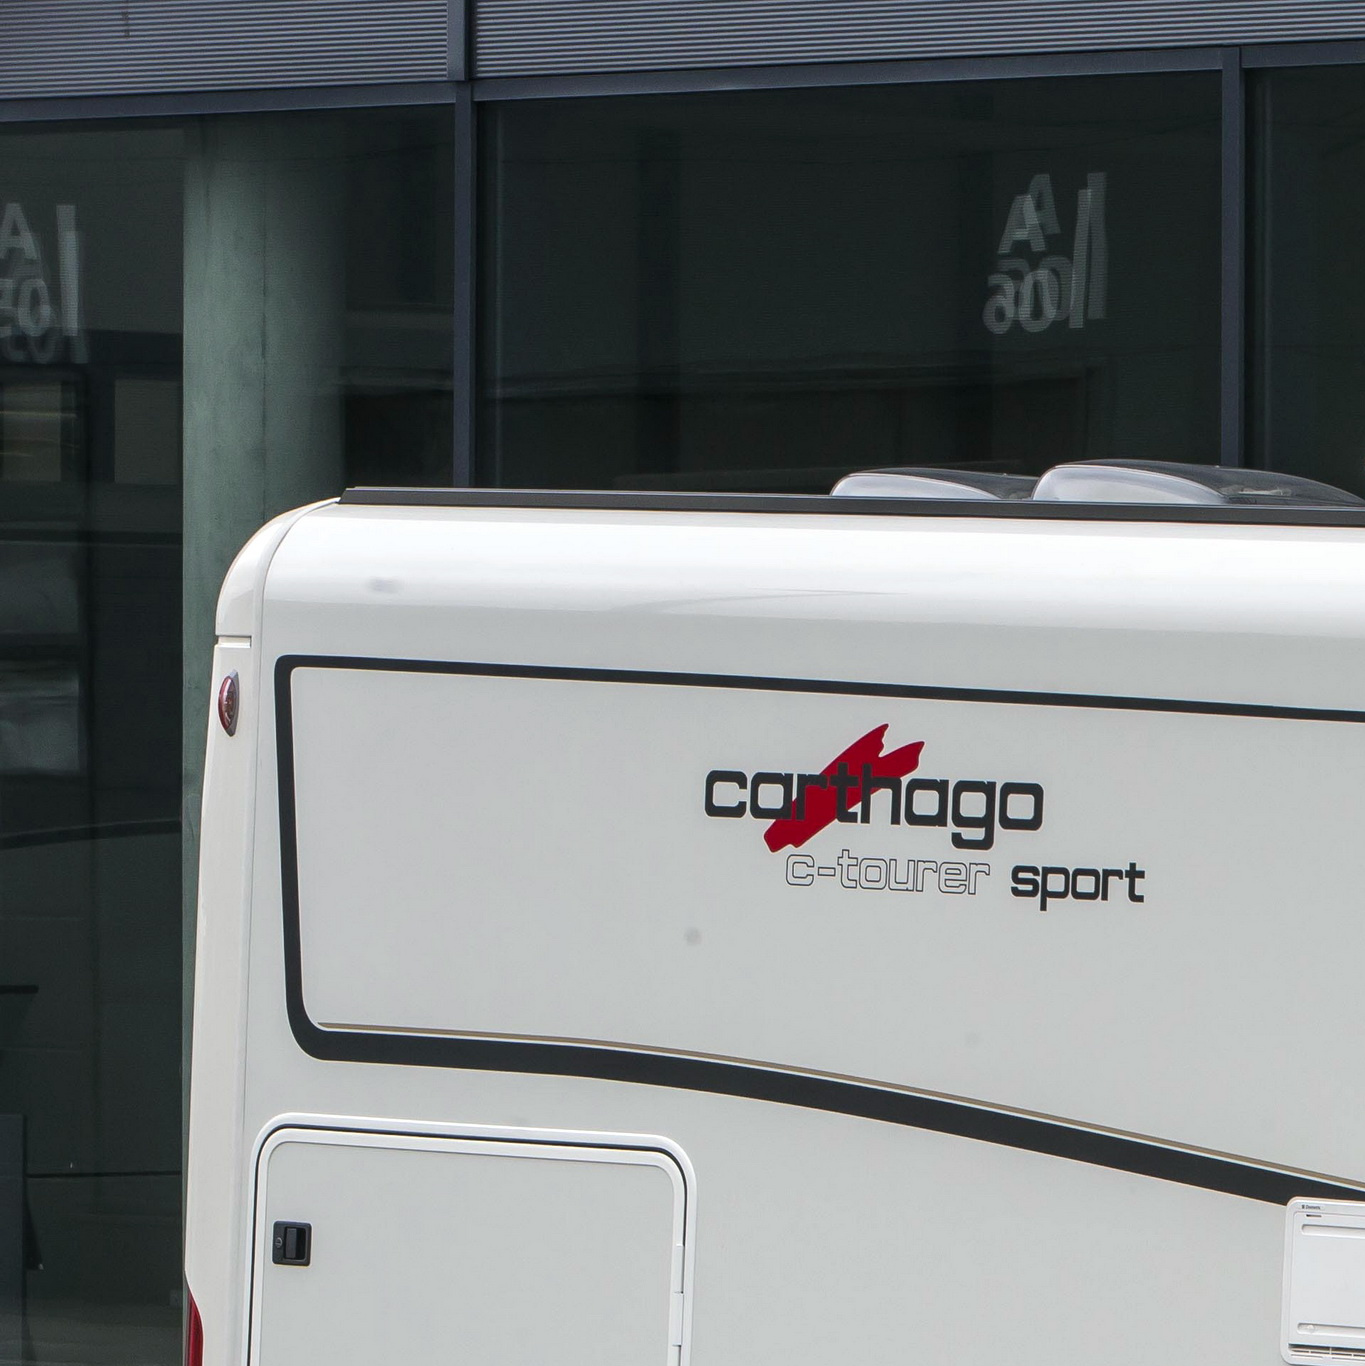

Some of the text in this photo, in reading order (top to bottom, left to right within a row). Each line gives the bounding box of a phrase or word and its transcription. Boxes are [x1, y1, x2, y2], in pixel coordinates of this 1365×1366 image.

[703, 761, 1045, 851] carthago
[785, 848, 1147, 912] c-tourer sport
